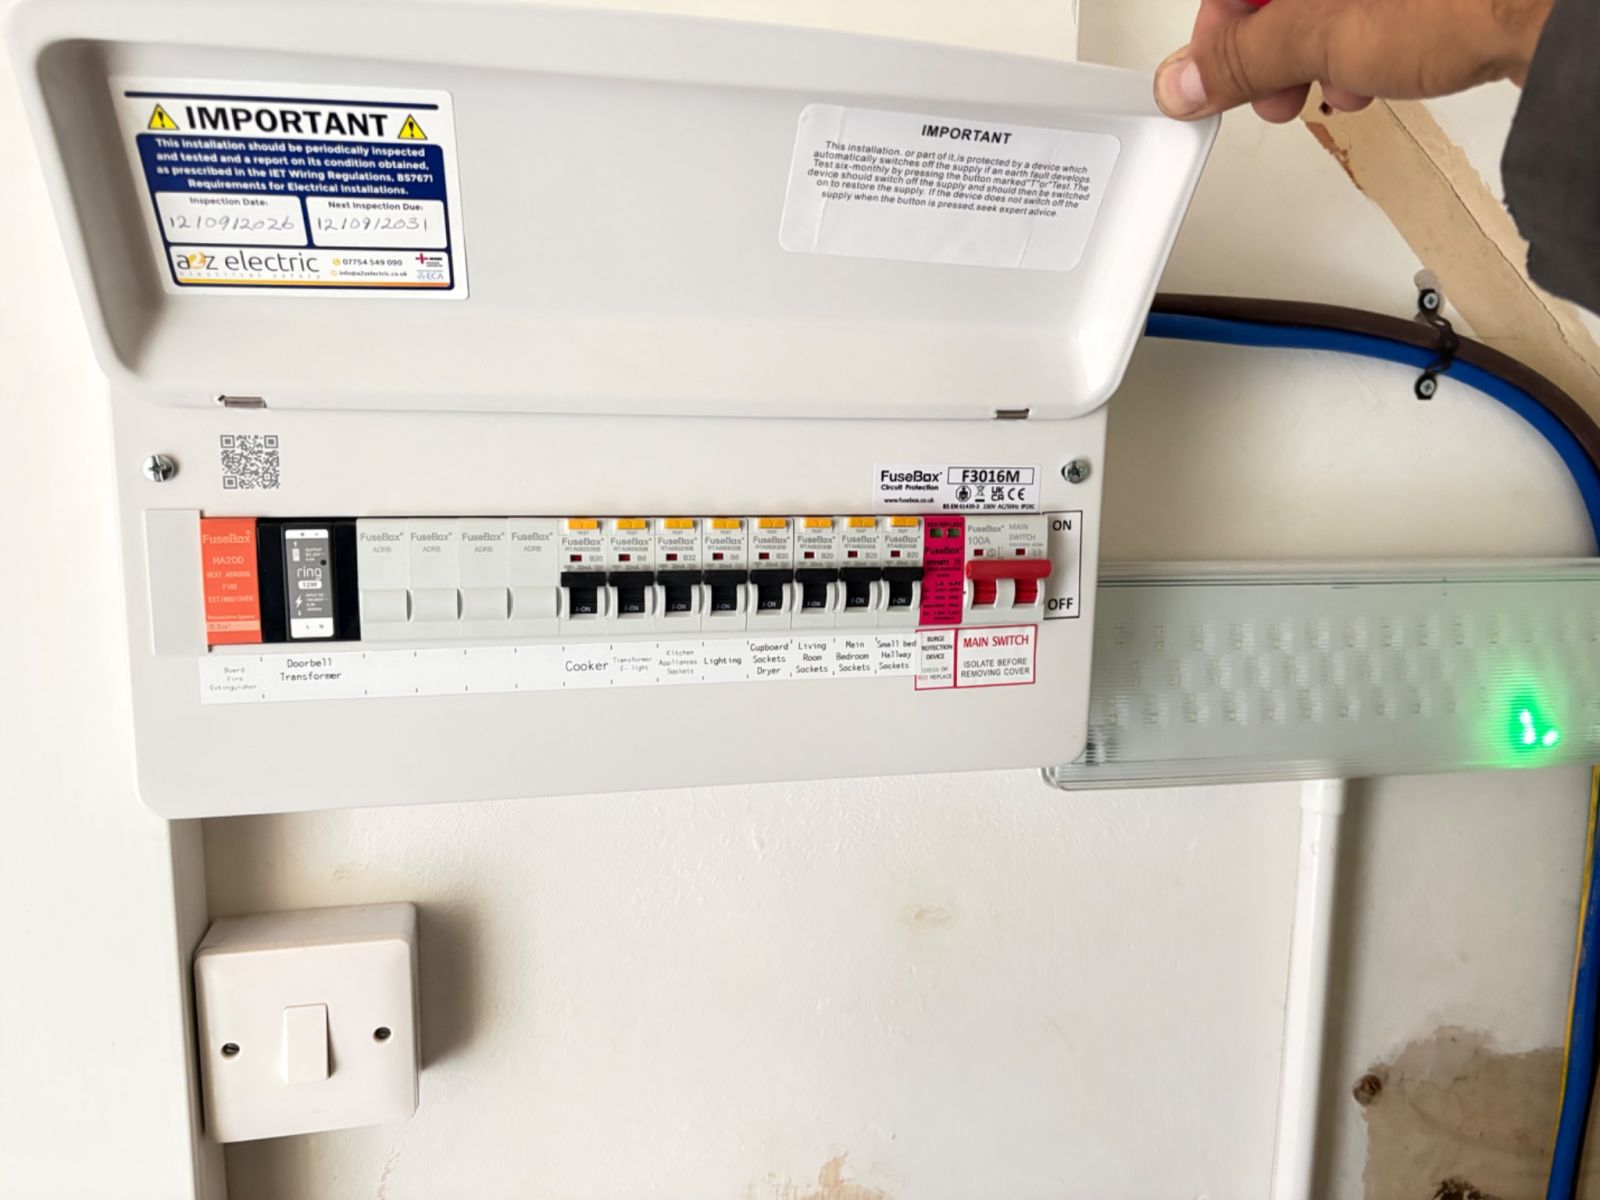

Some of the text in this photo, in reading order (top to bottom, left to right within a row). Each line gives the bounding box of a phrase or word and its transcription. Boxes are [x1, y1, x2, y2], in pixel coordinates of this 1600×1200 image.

[185, 106, 388, 136] IMPORTANT
[921, 124, 1012, 144] IMPORTANT
[155, 138, 425, 157] This installation should be periodically inspected
[156, 152, 178, 161] and
[180, 152, 217, 162] tested
[220, 154, 241, 163] and
[244, 156, 251, 164] a
[253, 156, 289, 166] report
[308, 157, 321, 166] its
[324, 158, 376, 168] condition
[378, 160, 429, 171] obtained,
[825, 140, 845, 151] This
[916, 150, 935, 160] part
[937, 151, 948, 159] of
[966, 155, 1010, 168] protected
[1012, 159, 1023, 170] by
[1032, 161, 1060, 172] device
[1062, 164, 1088, 174] which
[813, 150, 878, 164] automatically
[879, 156, 920, 168] switches
[921, 159, 934, 168] off
[936, 160, 951, 170] the
[952, 162, 982, 174] supply
[992, 167, 1003, 175] an
[1005, 168, 1028, 177] earth
[1030, 170, 1050, 180] fault
[156, 166, 170, 174] as
[172, 165, 233, 176] prescribed
[235, 167, 245, 177] in
[247, 167, 266, 178] the
[268, 169, 287, 178] IET
[288, 169, 325, 181] Wiring
[397, 173, 433, 183] BS7671
[814, 158, 1089, 192] Test six-monthly by pressing the button The
[187, 179, 409, 195] Requirements for Electrical Installations.
[807, 168, 1090, 201] device should switch off the supply and should then be switched
[830, 179, 840, 187] to
[842, 181, 875, 190] restore
[877, 183, 892, 192] the
[937, 188, 951, 198] the
[953, 190, 982, 200] device
[985, 193, 1006, 203] does
[1023, 196, 1050, 207] switch
[1052, 199, 1064, 208] off
[1064, 200, 1079, 209] the
[189, 197, 269, 207] Inspection Date:
[328, 201, 424, 211] Next Inspection Due:
[821, 190, 852, 201] supply
[854, 192, 879, 202] when
[880, 195, 895, 204] the
[897, 196, 926, 206] button
[999, 206, 1027, 216] expert
[224, 250, 321, 272] electric
[881, 470, 1020, 483] FuseBox F3016M
[968, 525, 1001, 533] FuseBox
[1052, 520, 1072, 531] ON
[202, 534, 251, 544] FuseBox
[360, 532, 400, 542] FuseBox
[410, 532, 449, 541] FuseBox
[462, 532, 501, 541] FuseBox
[511, 532, 550, 541] FuseBox
[657, 537, 695, 545] FuseBox
[705, 536, 742, 544] FuseBox
[842, 535, 877, 543] FuseBox
[885, 535, 918, 543] FuseBox
[968, 536, 991, 545] 100A
[297, 566, 322, 581] ring
[1047, 598, 1073, 610] OFF
[798, 642, 827, 651] Living
[877, 639, 917, 648] Small bed
[963, 635, 1029, 648] MAIN SWITCH
[750, 643, 789, 652] Cupboard
[753, 655, 786, 664] Sockets
[803, 653, 823, 661] Room
[836, 652, 869, 660] Bedroom
[881, 650, 912, 659] Hallway
[287, 657, 332, 668] Doorbell
[565, 660, 609, 672] Cooker
[704, 656, 742, 666] Lighting
[879, 661, 909, 670] Sockets
[963, 657, 1028, 668] ISOLATE BEFORE
[757, 666, 781, 676] Dryer
[796, 665, 828, 674] Sockets
[839, 663, 871, 672] Sockets
[961, 666, 1030, 678] REMOVING COVER
[280, 672, 342, 681] Transformer
